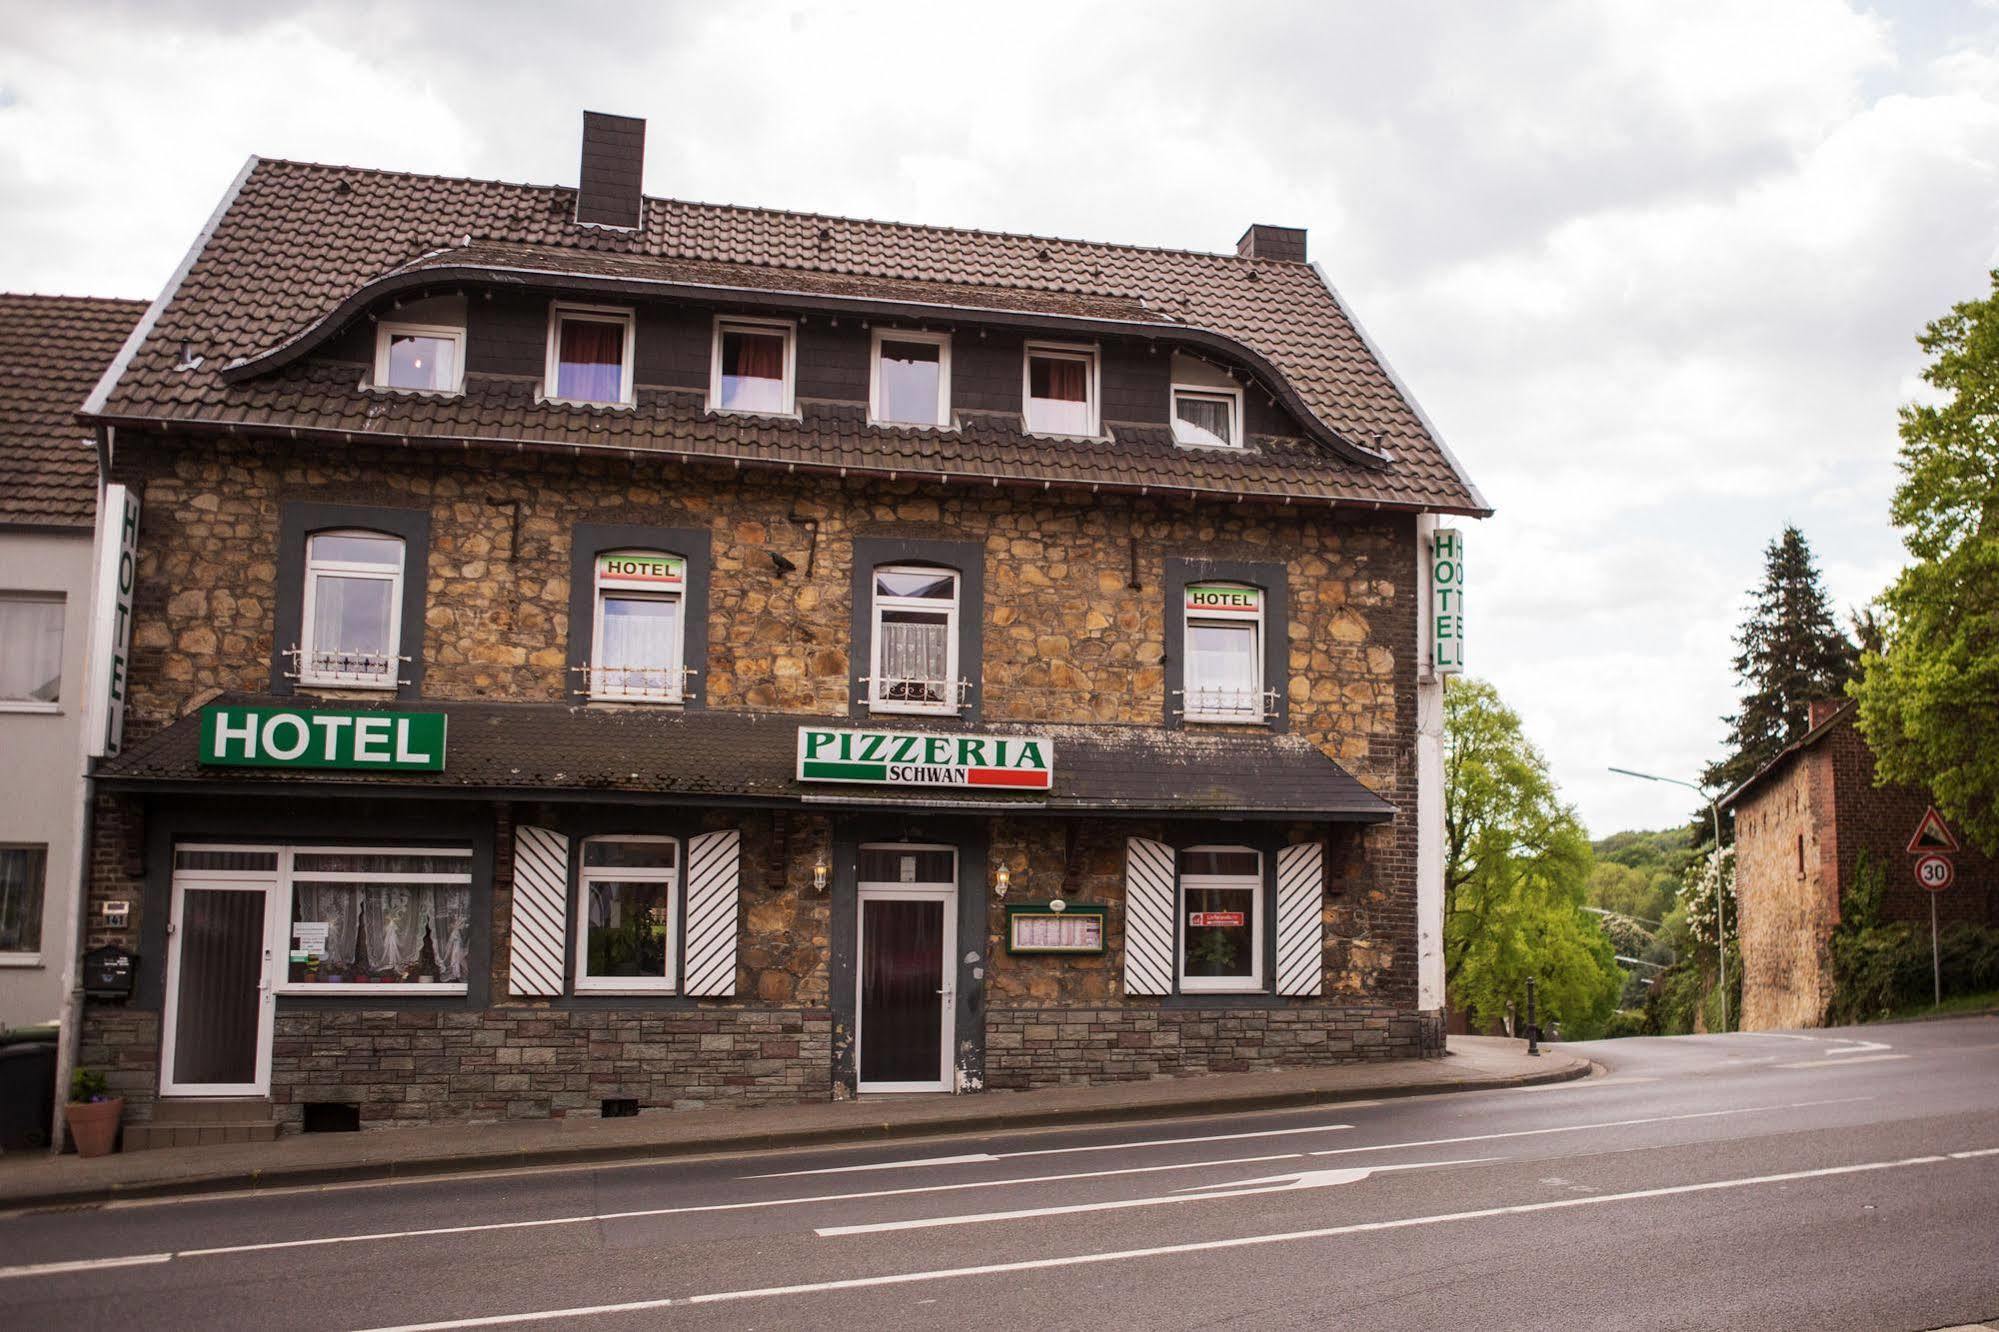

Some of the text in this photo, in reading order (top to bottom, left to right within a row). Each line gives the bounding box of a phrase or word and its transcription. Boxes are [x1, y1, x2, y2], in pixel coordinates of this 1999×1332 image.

[608, 561, 676, 577] HOTEL
[1193, 593, 1253, 606] HOTEL
[1435, 535, 1454, 665] HOTEL
[108, 503, 137, 753] HOTEL
[214, 712, 430, 763] HOTEL
[804, 732, 1047, 769] PIZZERIA
[889, 765, 966, 784] SCHWAN
[1924, 865, 1945, 881] 30
